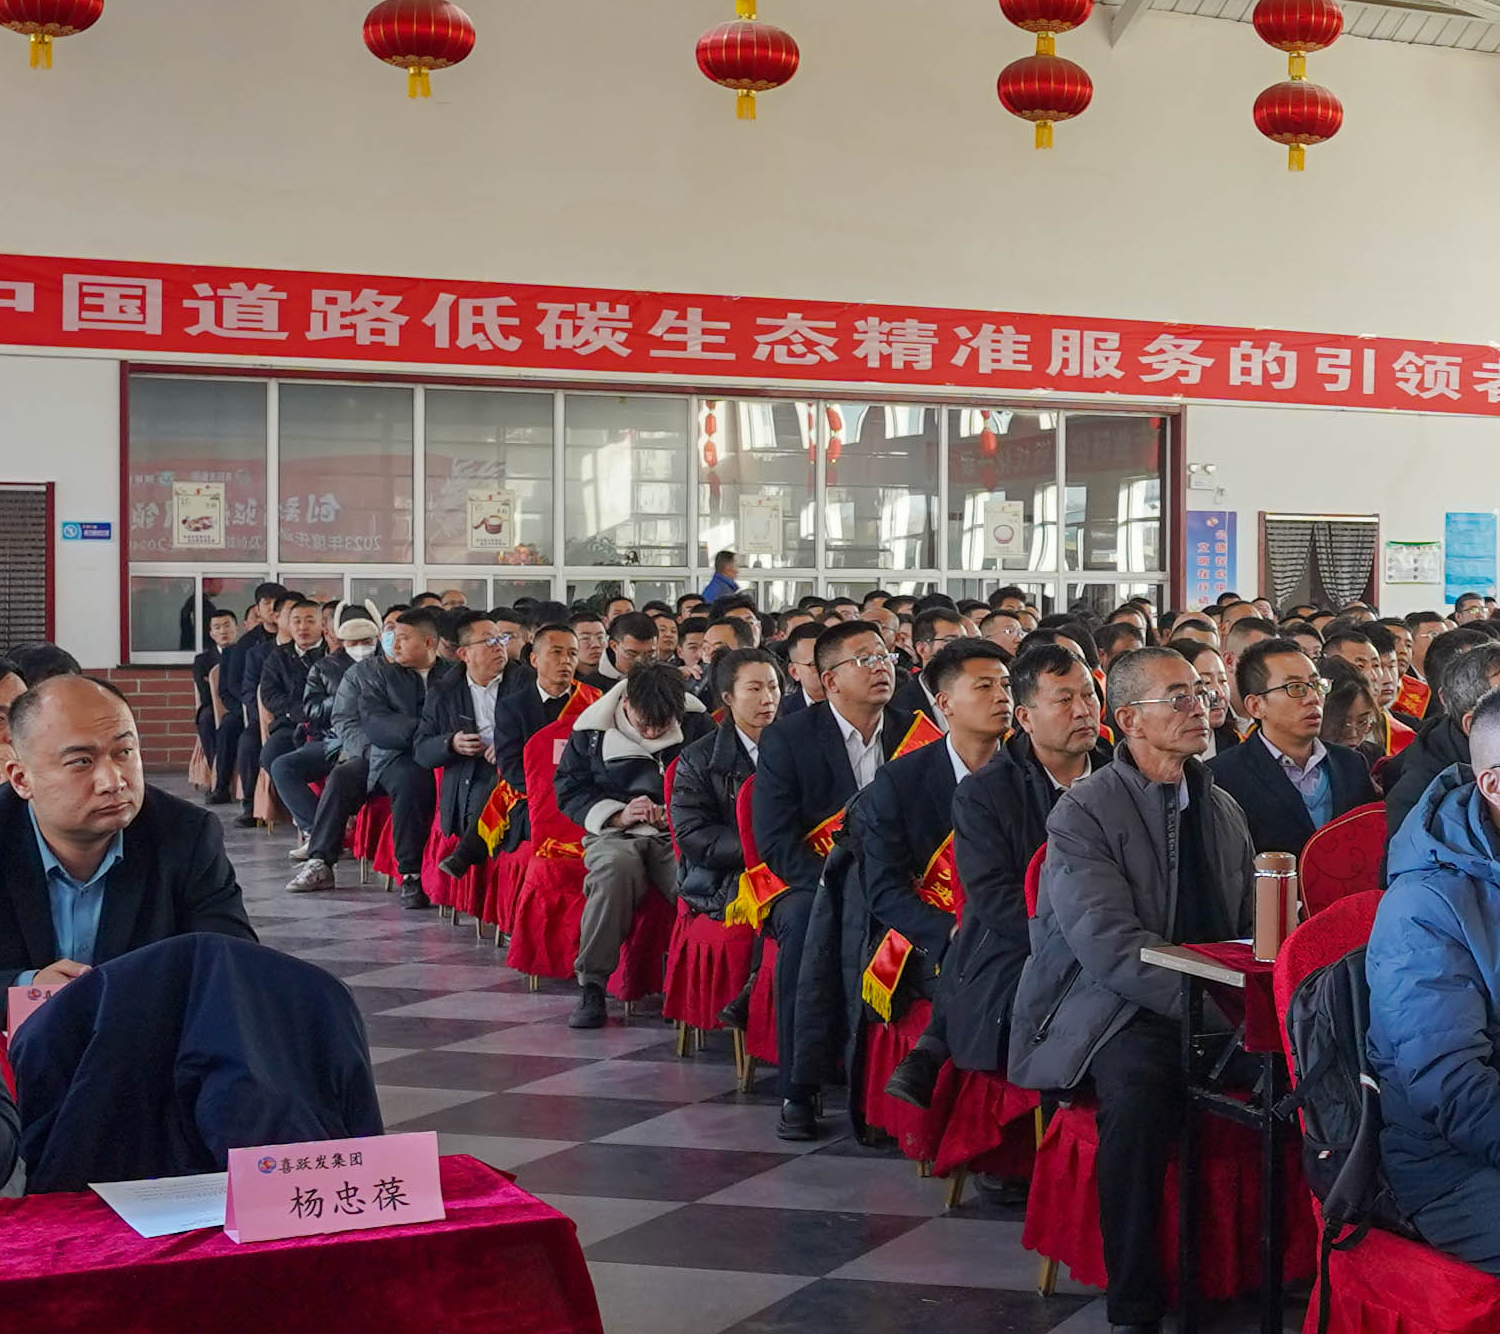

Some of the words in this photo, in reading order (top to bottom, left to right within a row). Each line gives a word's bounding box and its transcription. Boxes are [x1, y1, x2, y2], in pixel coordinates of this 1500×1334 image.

[277, 1152, 364, 1175] 喜跃发集团
[289, 1176, 411, 1220] 杨忠葆
